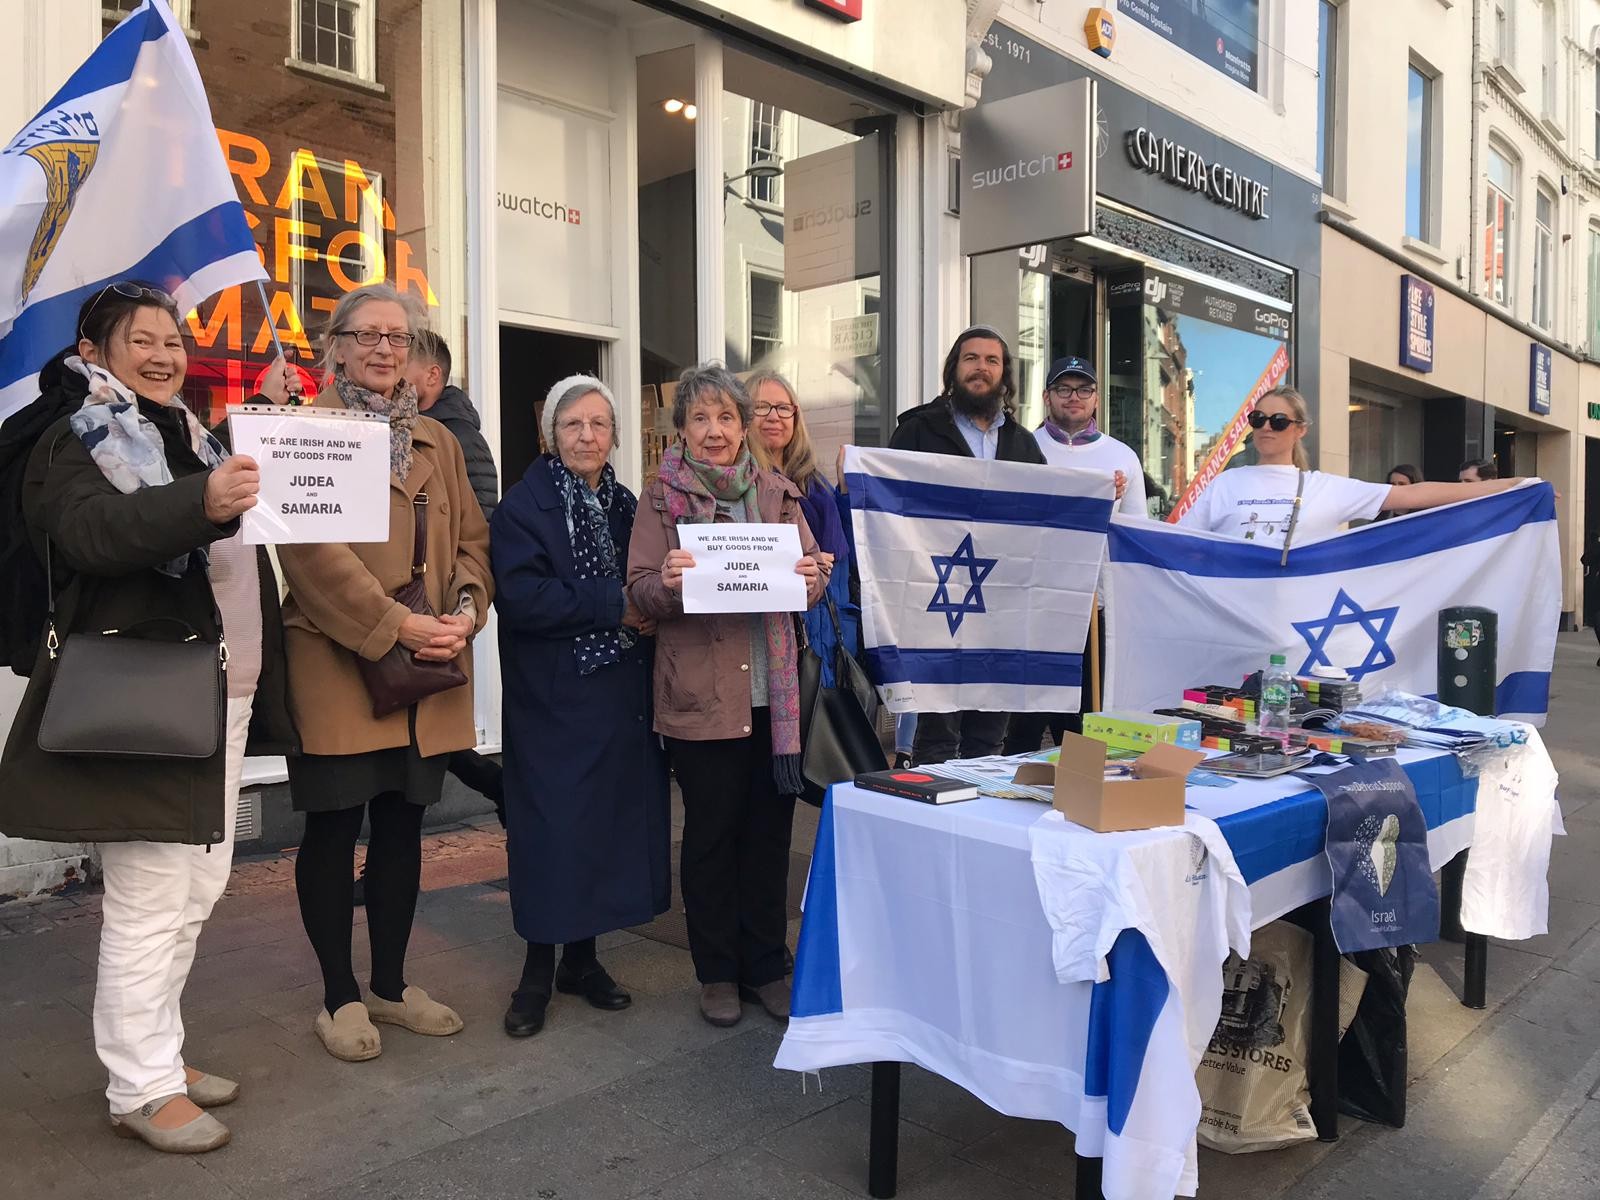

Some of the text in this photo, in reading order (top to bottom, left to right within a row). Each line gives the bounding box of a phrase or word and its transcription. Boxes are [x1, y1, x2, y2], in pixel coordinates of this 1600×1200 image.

[1131, 2, 1149, 20] Centre
[1150, 13, 1173, 35] Upstairs
[1102, 22, 1113, 38] ADT
[984, 33, 1031, 64] st. 1971
[972, 153, 1056, 190] swatch
[1136, 127, 1270, 219] CAMERA CENTRE
[1205, 295, 1238, 313] AUTHORISED
[1209, 307, 1233, 322] RETAILER
[1255, 308, 1289, 329] GoPro
[1411, 309, 1428, 333] STYLE
[1410, 333, 1432, 357] SPORTS
[260, 437, 362, 450] WE ARE IRISH AND WE
[1178, 441, 1231, 520] CLEARANCE
[1272, 352, 1289, 379] ON!
[272, 451, 353, 462] BUY GOODS FROM
[289, 475, 335, 488] JUDEA
[280, 503, 343, 515] SAMARIA
[724, 562, 760, 571] JUDEA
[716, 582, 769, 592] SAMARIA
[1371, 908, 1397, 924] Israel
[1230, 1044, 1293, 1073] STORES
[1226, 1061, 1247, 1075] Value
